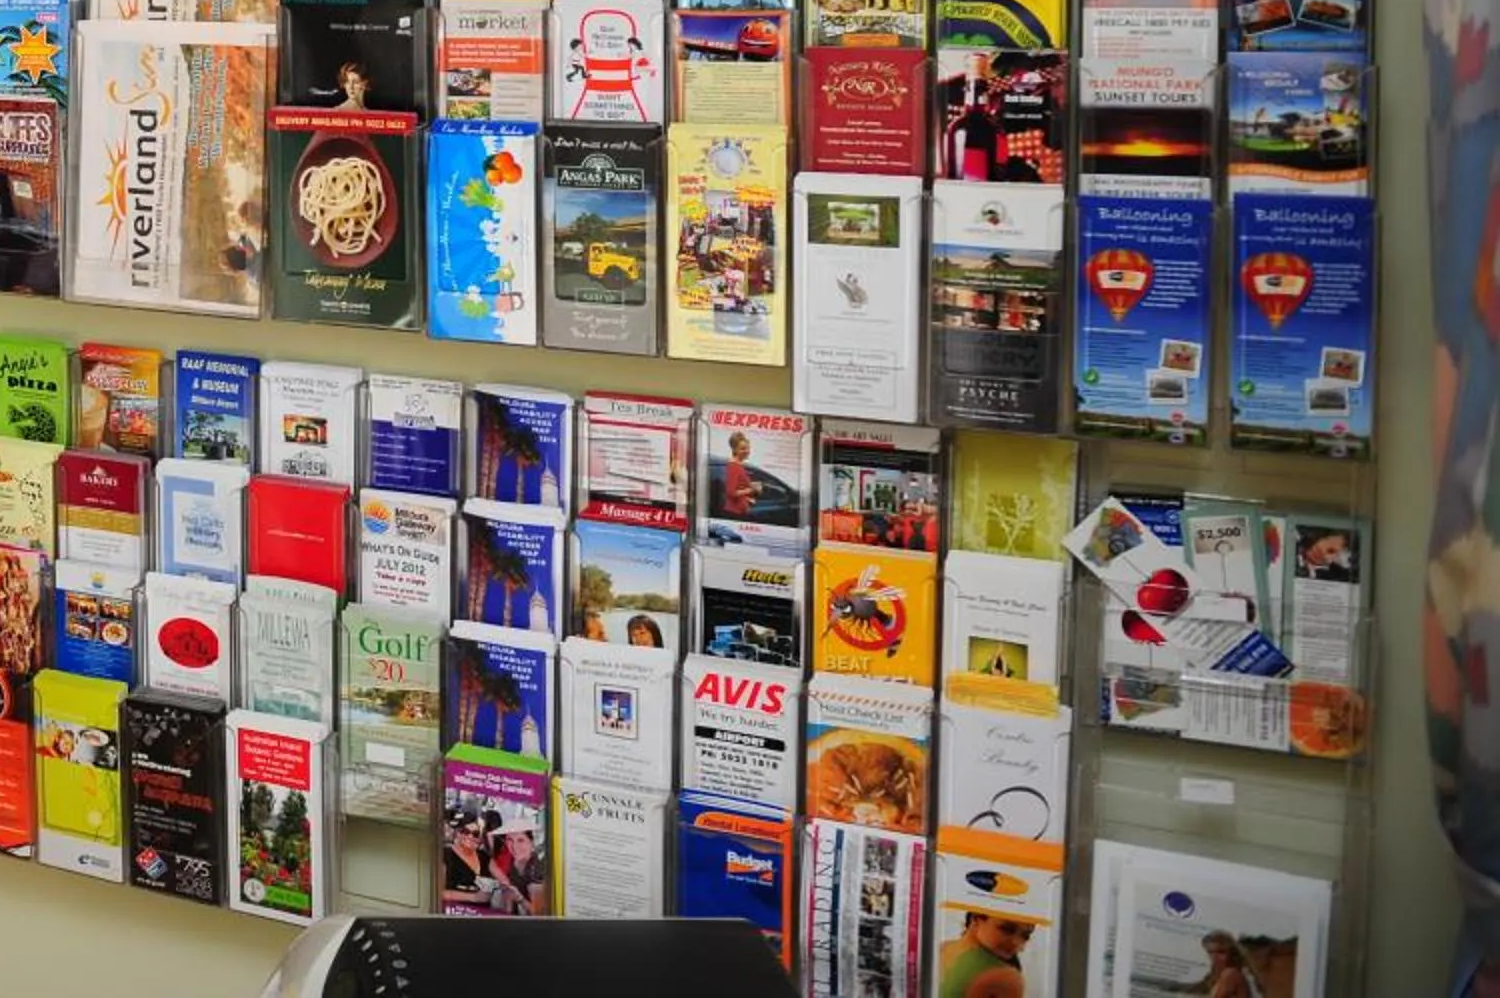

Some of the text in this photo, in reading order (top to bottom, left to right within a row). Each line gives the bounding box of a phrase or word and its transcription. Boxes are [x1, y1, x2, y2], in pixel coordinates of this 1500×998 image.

[1116, 67, 1174, 77] MUNGO
[1090, 79, 1161, 90] NATIONAL
[1093, 92, 1197, 103] SUNSET TOURS
[605, 171, 642, 185] PARK
[128, 108, 158, 288] riverland
[1098, 207, 1193, 227] Ballooning
[1255, 208, 1355, 230] Ballooning
[182, 357, 205, 370] RAAF
[201, 379, 240, 395] MUSEUM
[637, 402, 673, 417] Break
[853, 431, 867, 440] ART
[374, 557, 427, 576] JULY 2012
[359, 622, 429, 657] Golf
[825, 654, 871, 672] BEAT
[694, 672, 786, 715] AVIS
[715, 730, 765, 747] AIRPORT
[597, 807, 645, 824] FRUITS
[726, 851, 773, 873] Budget
